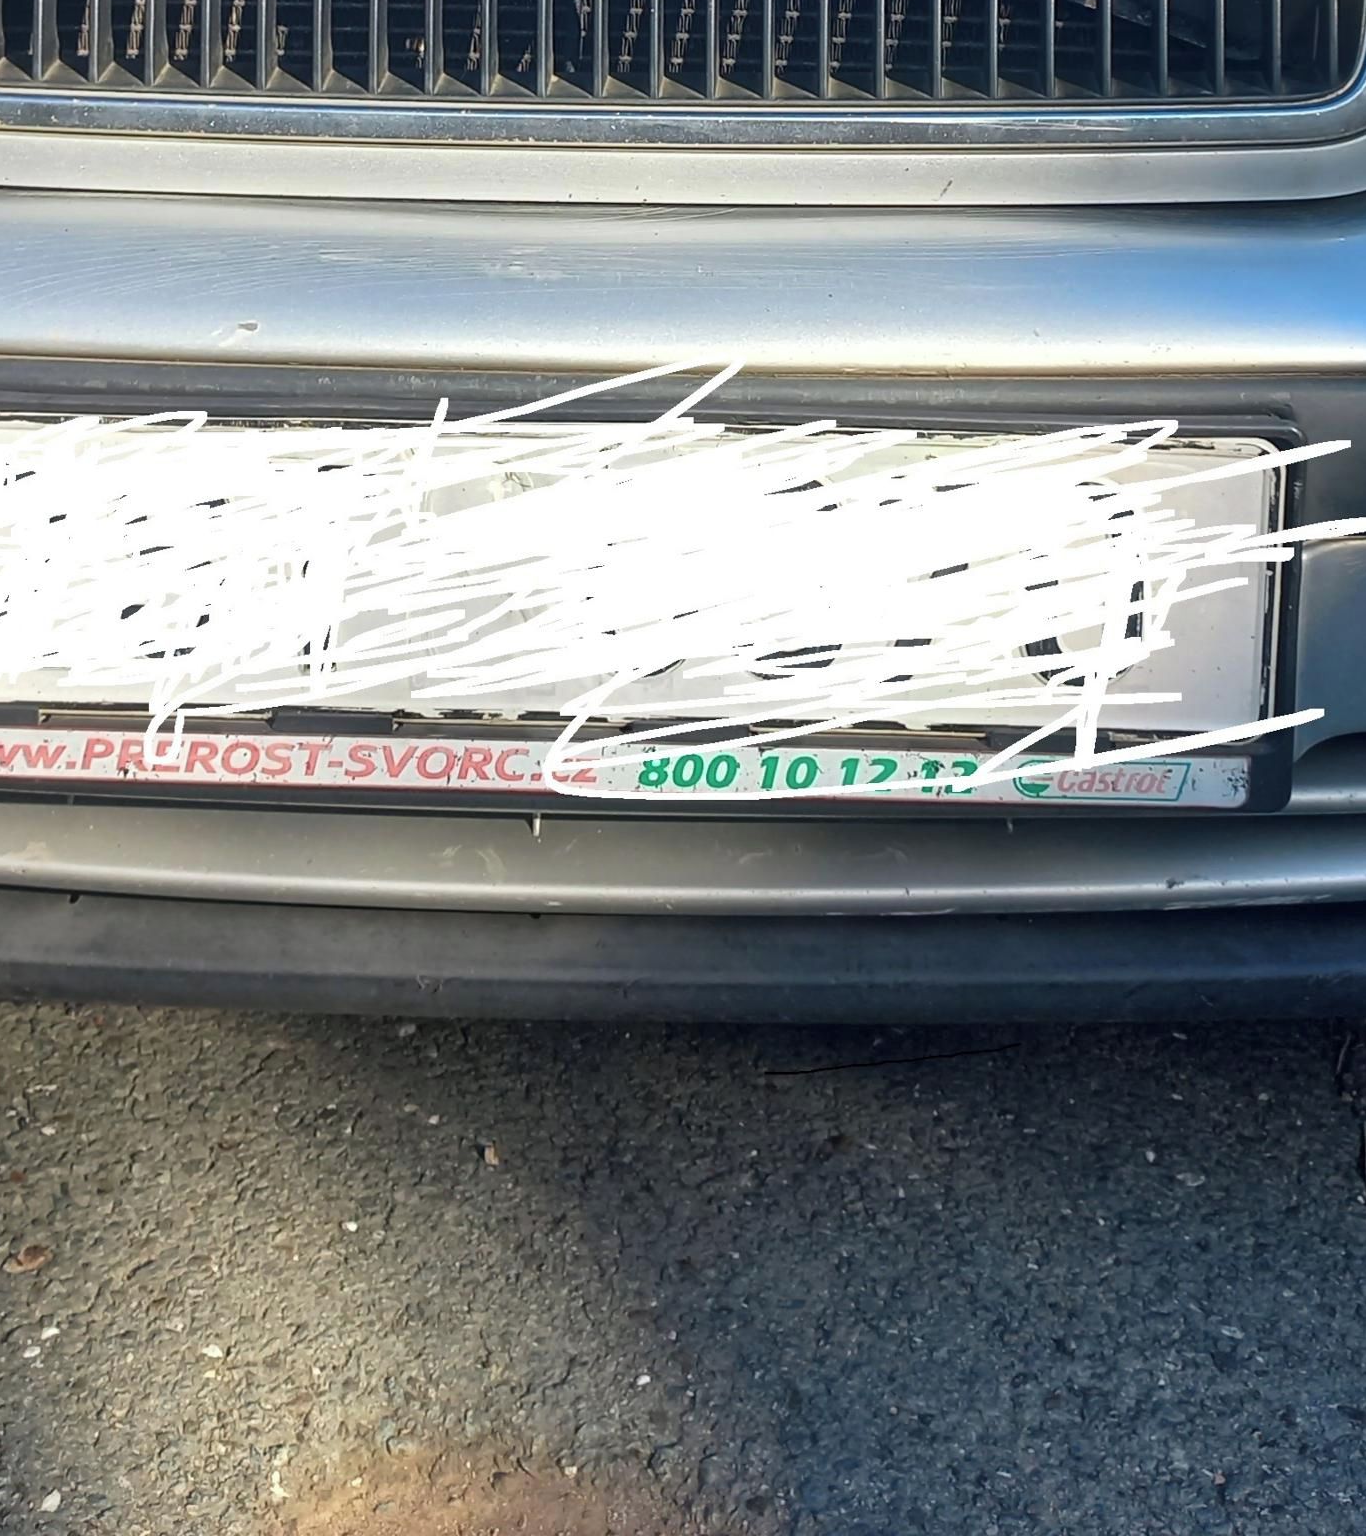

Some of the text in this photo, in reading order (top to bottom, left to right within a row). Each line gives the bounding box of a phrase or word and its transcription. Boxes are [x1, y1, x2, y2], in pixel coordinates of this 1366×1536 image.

[638, 752, 740, 789] 800
[760, 755, 820, 790] 10
[840, 756, 899, 792] 12
